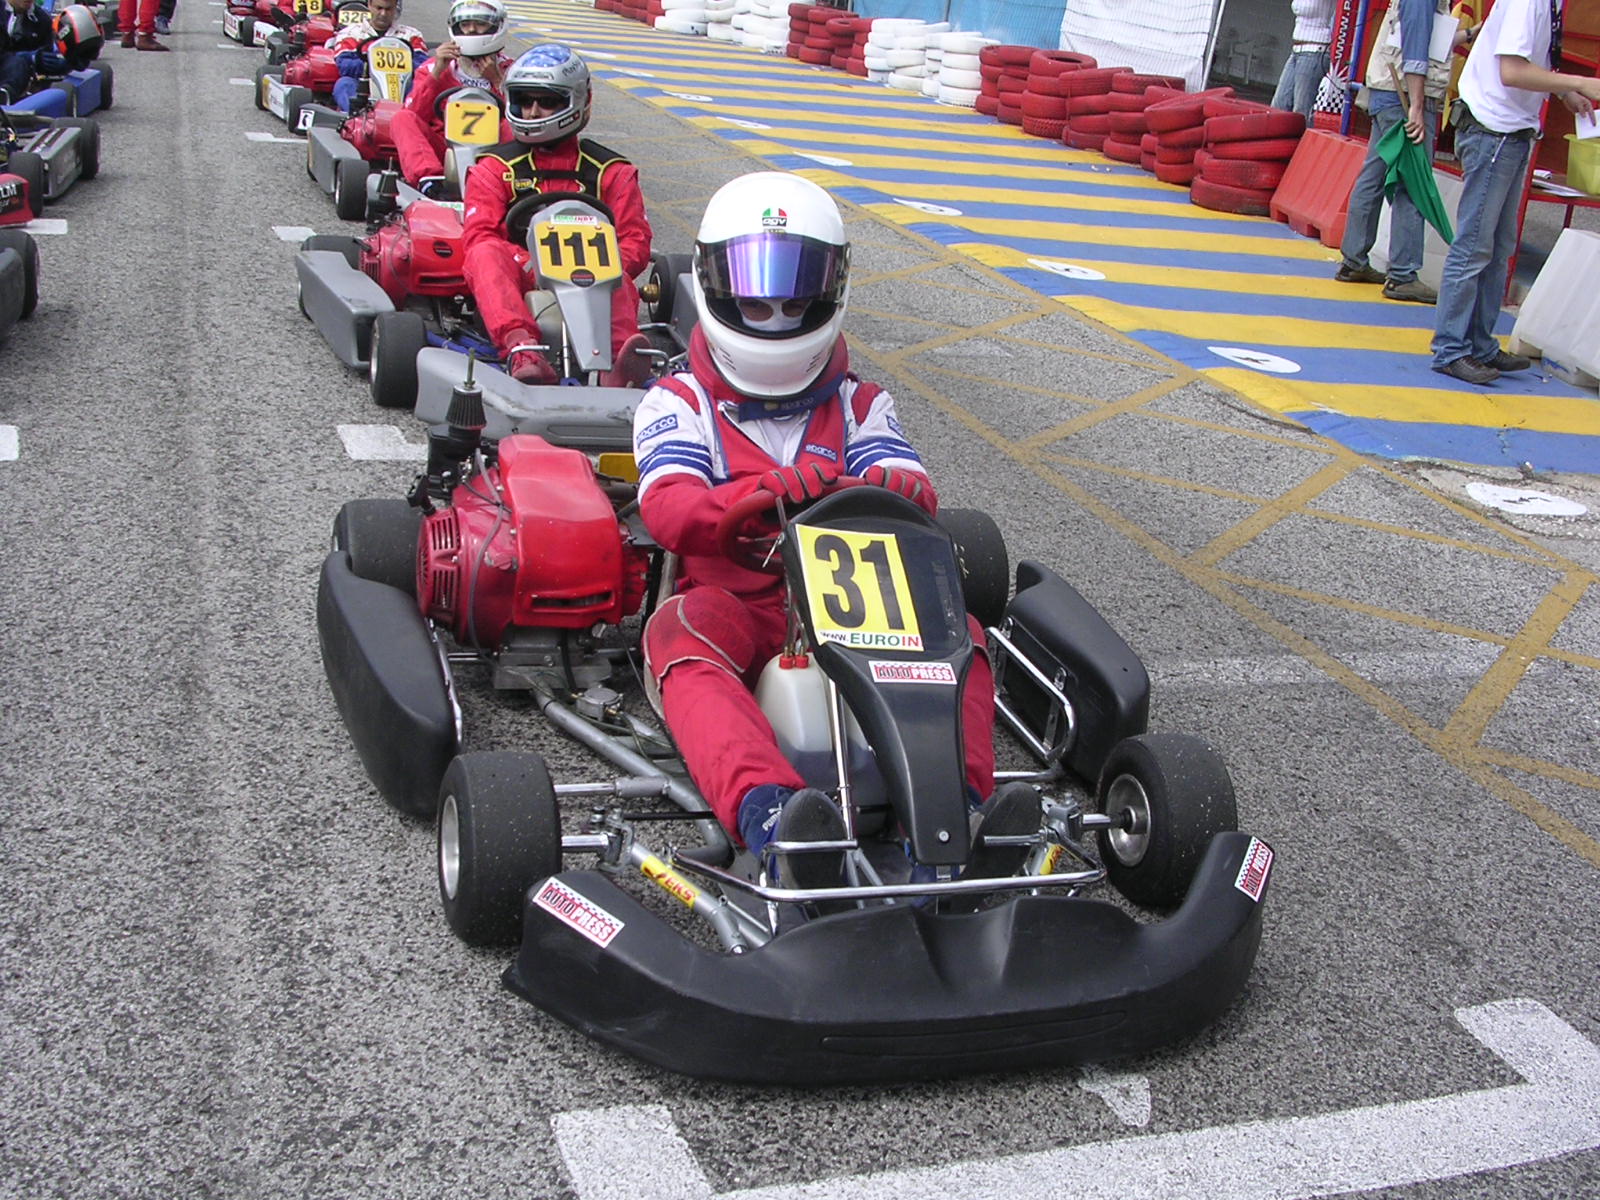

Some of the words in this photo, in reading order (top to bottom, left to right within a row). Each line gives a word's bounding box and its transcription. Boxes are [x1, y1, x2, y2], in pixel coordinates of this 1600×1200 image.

[376, 50, 406, 70] 302
[461, 111, 486, 136] 7
[540, 231, 611, 267] 111
[814, 533, 906, 631] 31
